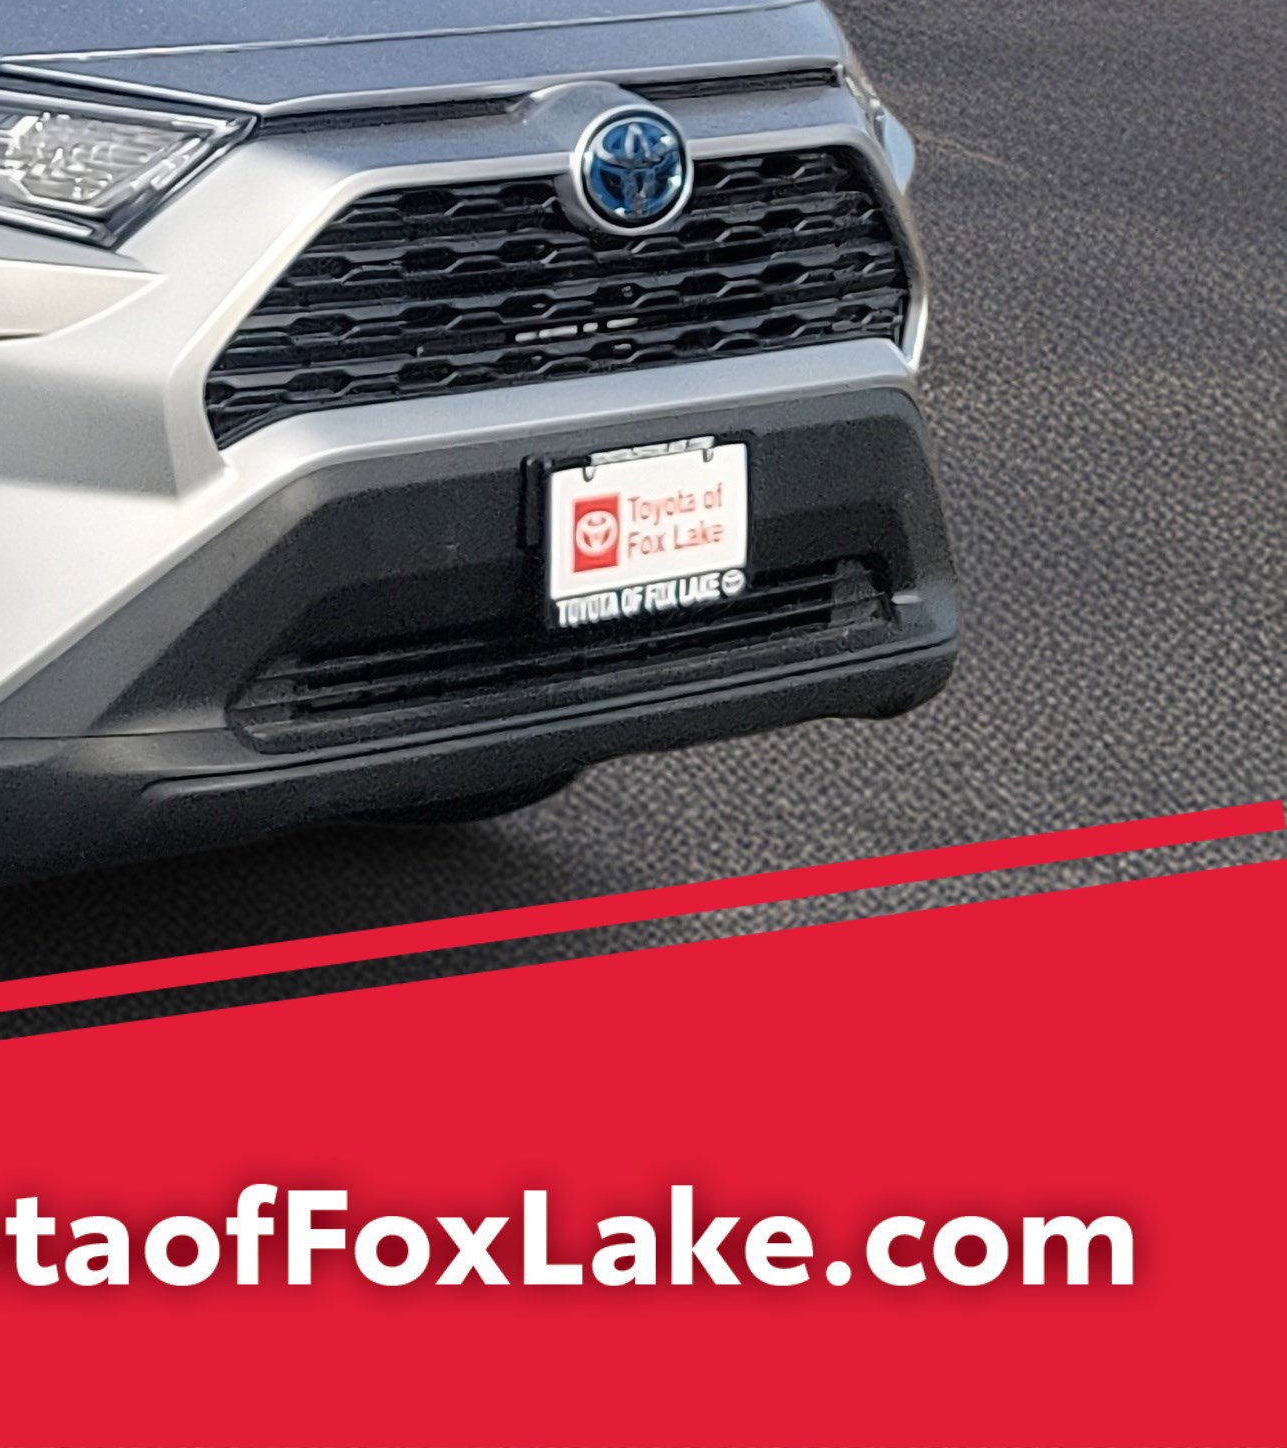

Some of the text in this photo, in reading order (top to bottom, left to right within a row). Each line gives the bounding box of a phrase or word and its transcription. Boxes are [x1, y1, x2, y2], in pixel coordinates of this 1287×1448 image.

[627, 482, 724, 525] Toyota of
[626, 520, 725, 559] Fox Lake
[556, 572, 722, 628] TOYOTA OF FOX LAKE
